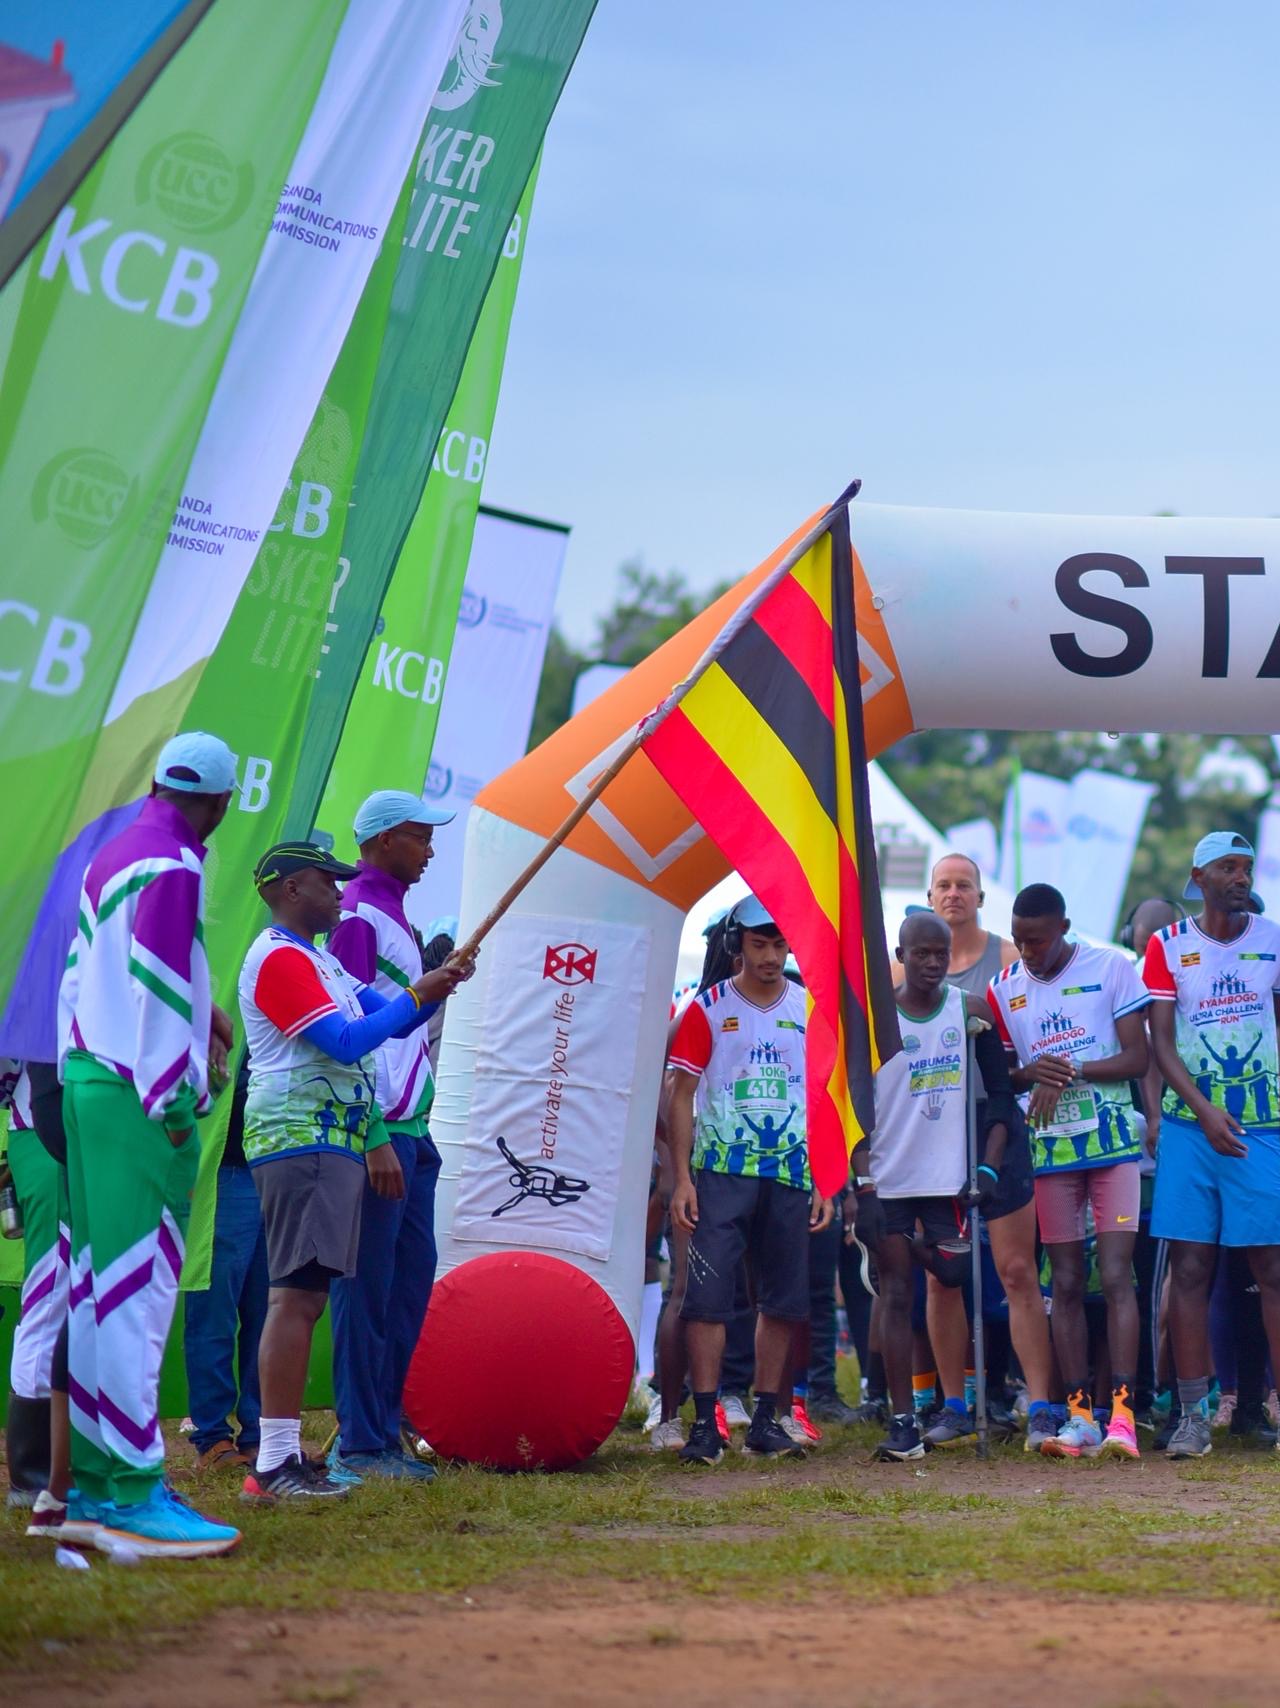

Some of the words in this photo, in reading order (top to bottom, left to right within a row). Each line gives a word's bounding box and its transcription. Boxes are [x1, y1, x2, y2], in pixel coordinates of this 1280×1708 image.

[416, 124, 495, 193] KER
[280, 183, 322, 206] GANDA
[270, 219, 340, 252] MMISSION
[274, 201, 378, 240] MMUNICATIONS
[39, 204, 220, 328] KCB
[0, 600, 92, 697] CB
[372, 642, 444, 705] KCB
[553, 992, 575, 1024] life
[1199, 993, 1258, 1009] KYAMBOGO
[1220, 1015, 1240, 1024] RUN
[551, 1027, 569, 1077] your
[1030, 1027, 1086, 1053] KYAMBOGO
[909, 1054, 961, 1071] MBUMSA
[747, 1080, 779, 1097] 416
[540, 1079, 563, 1160] activate
